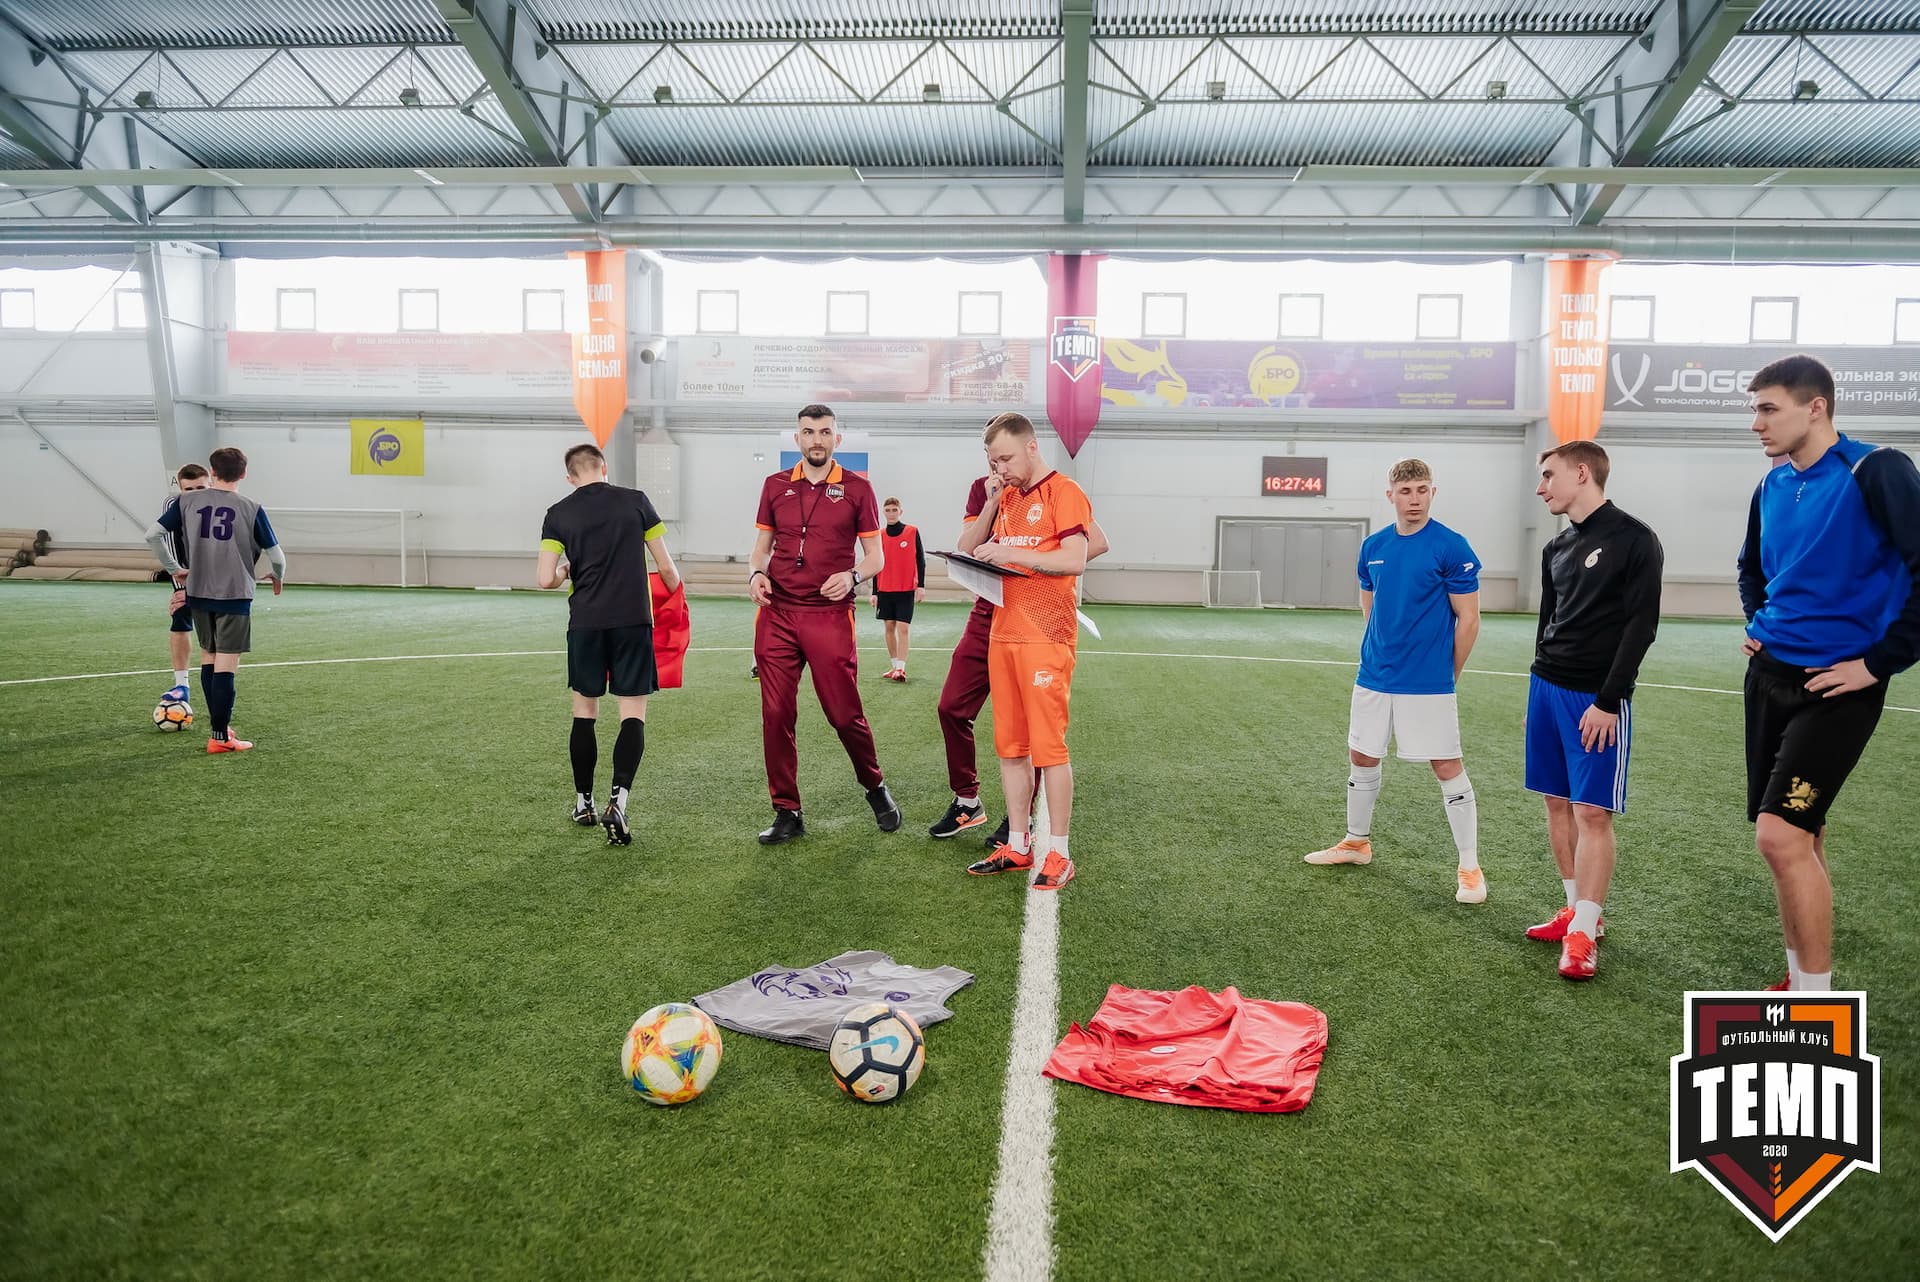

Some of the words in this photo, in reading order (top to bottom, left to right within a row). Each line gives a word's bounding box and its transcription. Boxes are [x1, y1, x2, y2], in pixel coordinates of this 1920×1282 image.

[587, 284, 613, 302] ЕМП
[582, 334, 616, 356] ОДНА
[1055, 334, 1097, 357] ТЕМП
[1553, 346, 1603, 367] ТОЛЬКО
[577, 359, 622, 379] СЕМЬЯ!
[1653, 361, 1757, 394] JÖGE
[1833, 369, 1894, 382] ольная
[682, 381, 714, 392] более
[1264, 476, 1322, 491] 16:27:44
[196, 505, 236, 541] 13
